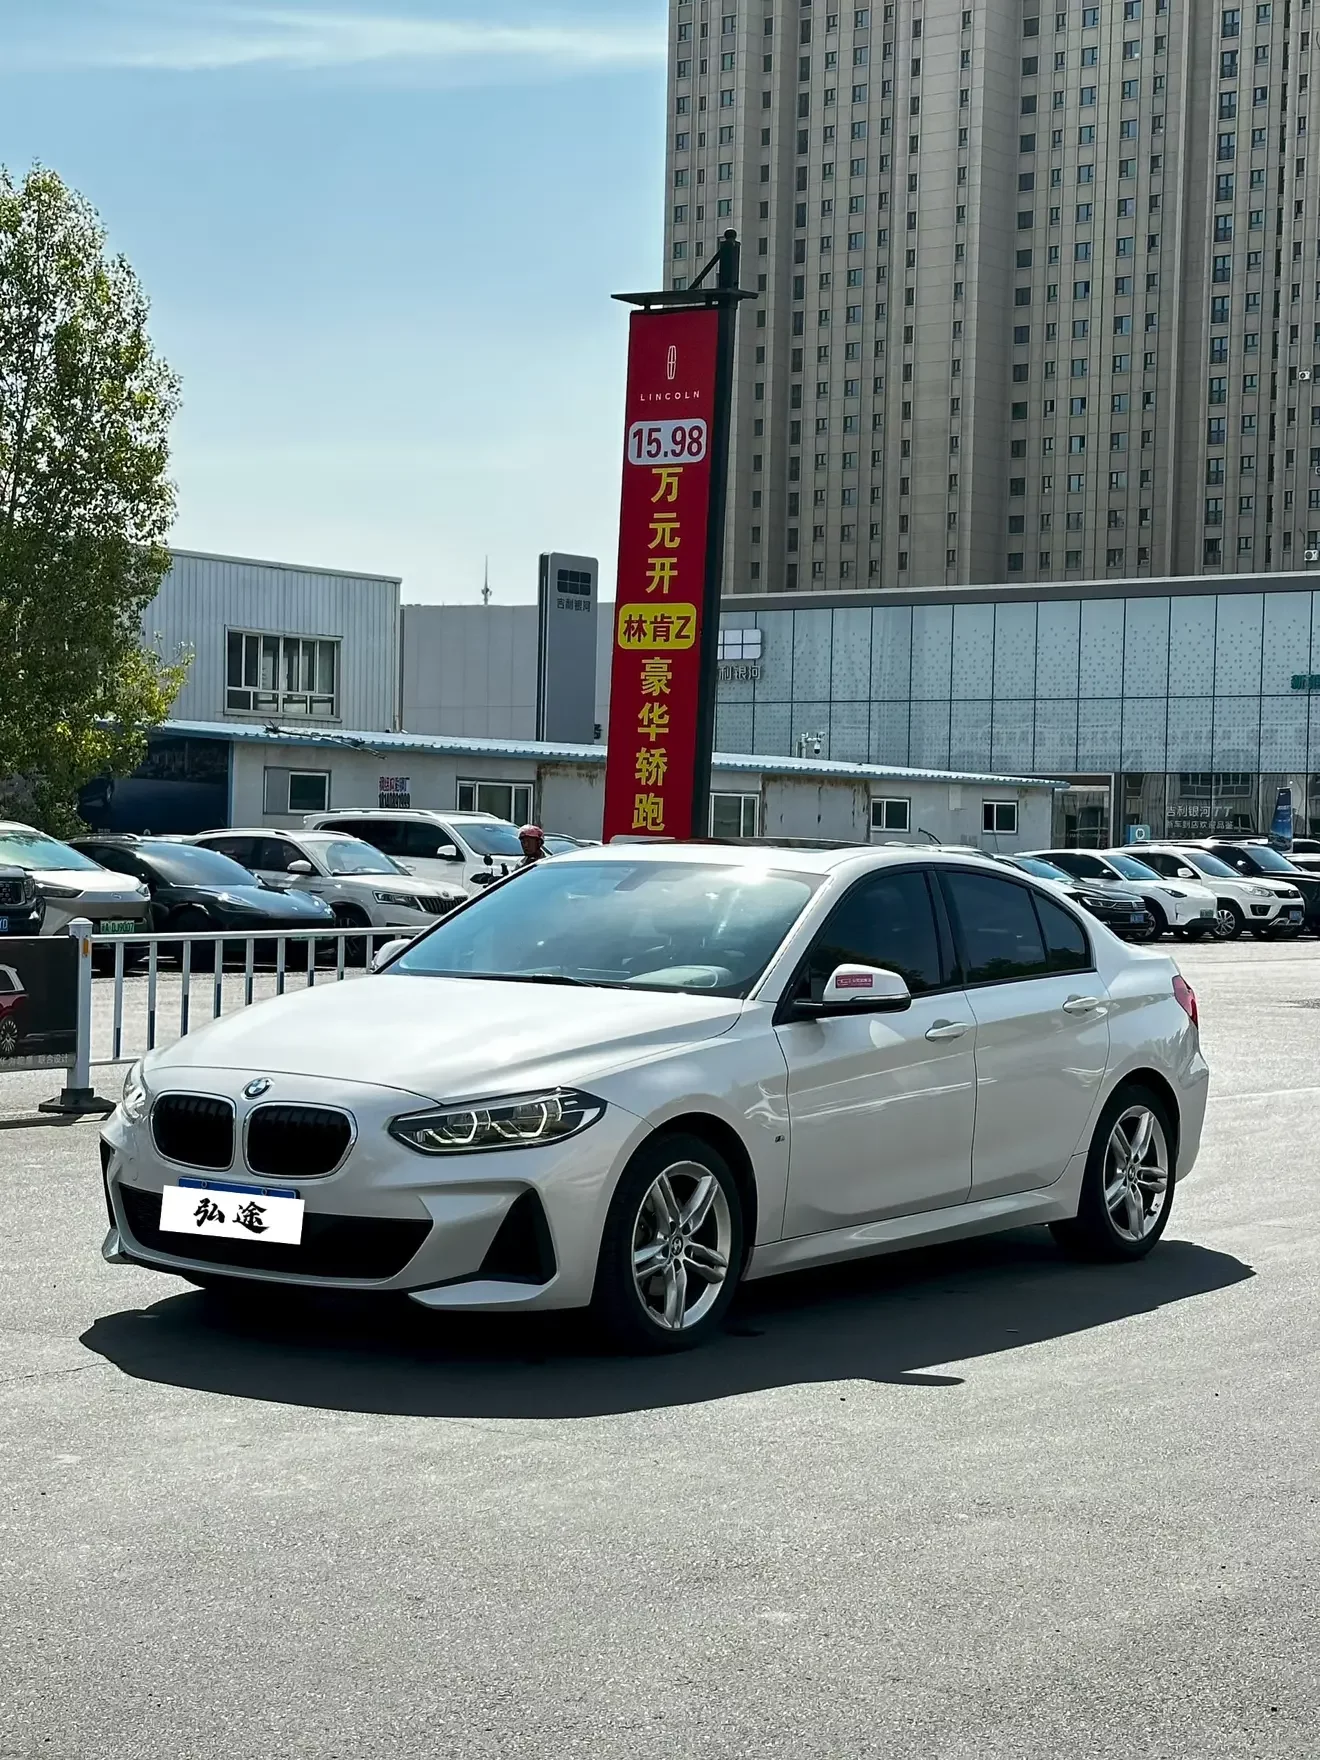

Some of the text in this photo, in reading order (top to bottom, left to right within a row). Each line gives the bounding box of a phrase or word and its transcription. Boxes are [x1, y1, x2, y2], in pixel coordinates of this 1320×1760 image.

[640, 390, 700, 401] LINCOLN
[632, 424, 703, 459] 15.98
[645, 466, 684, 594] 万元开
[622, 612, 692, 643] 林肯Z
[631, 656, 673, 831] 豪华轿跑
